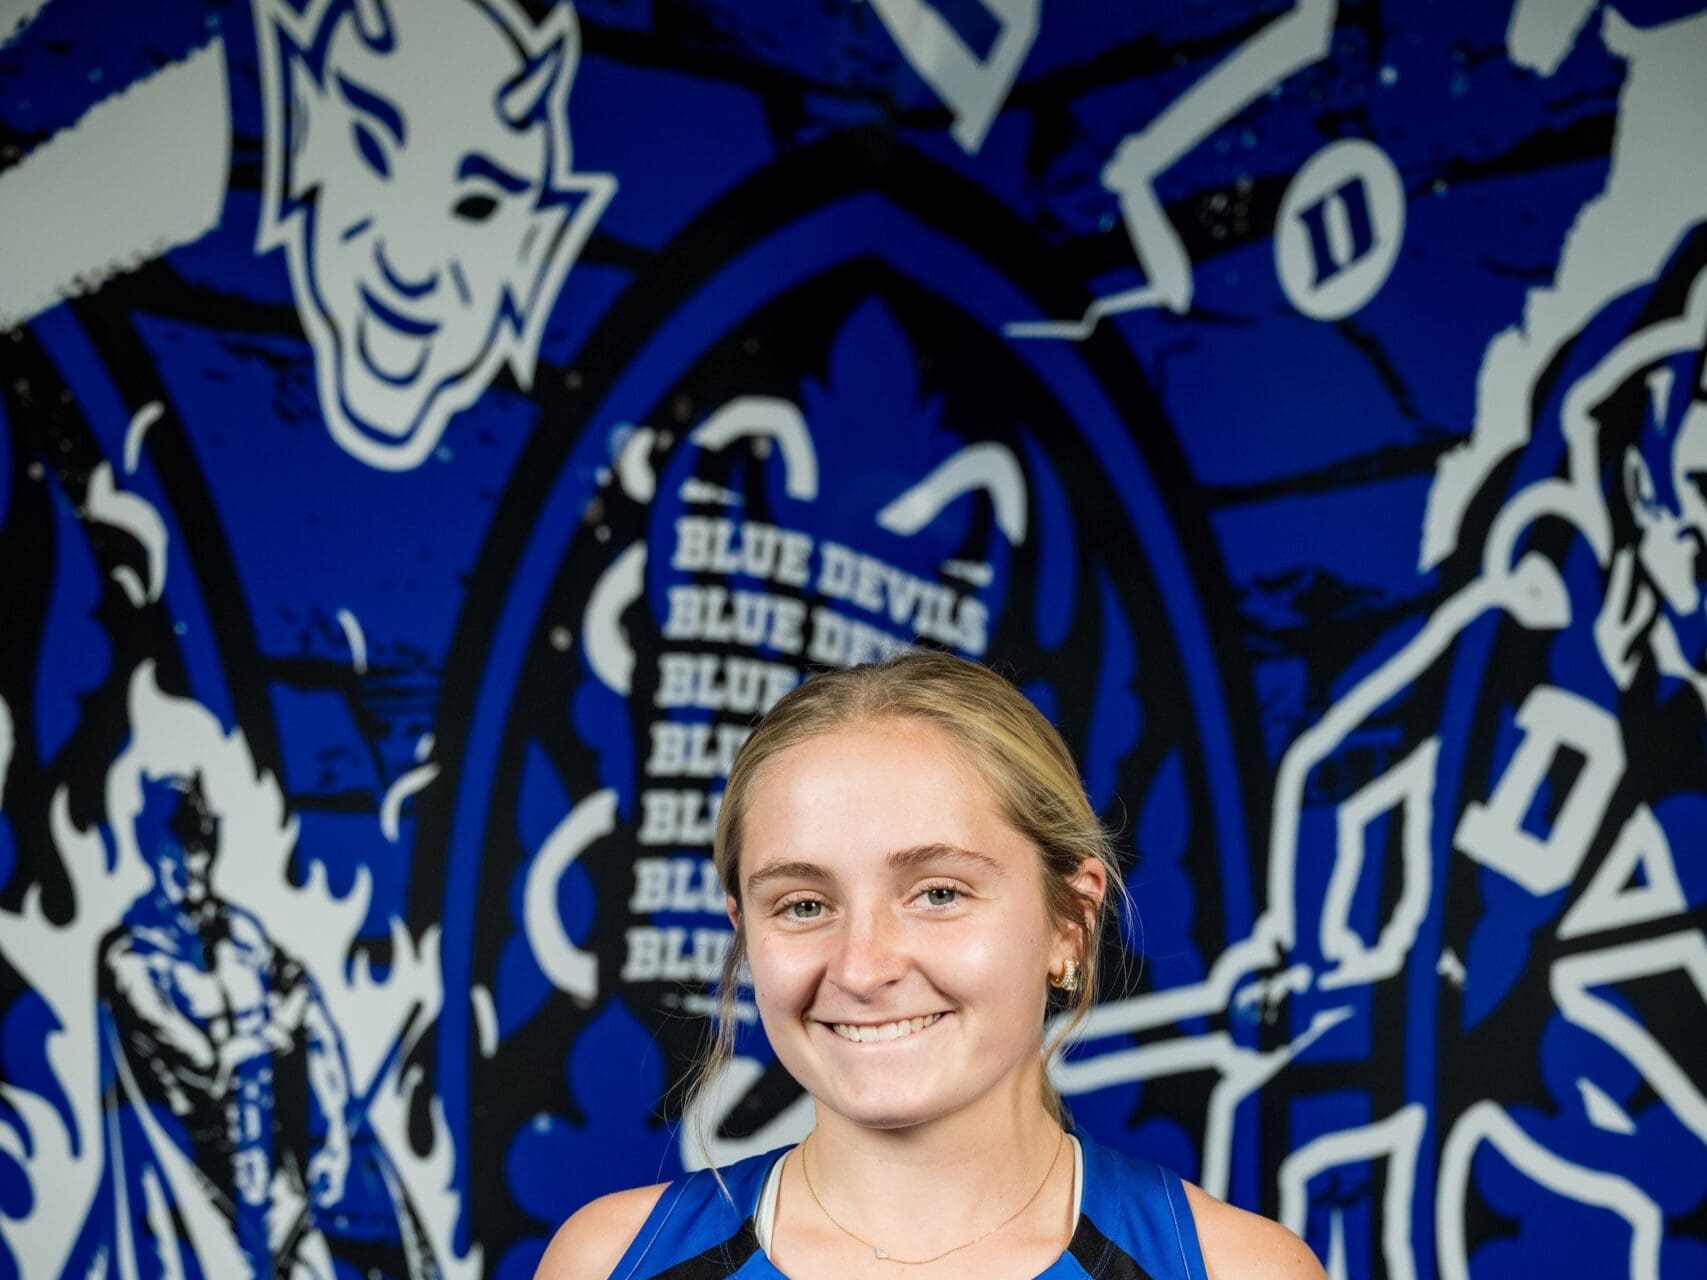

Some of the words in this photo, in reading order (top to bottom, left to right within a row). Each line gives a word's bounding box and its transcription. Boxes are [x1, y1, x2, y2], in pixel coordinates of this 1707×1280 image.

[662, 586, 807, 655] BLUE
[672, 516, 814, 589] BLUE
[816, 541, 990, 656] DEVILS
[629, 858, 728, 915] BLU
